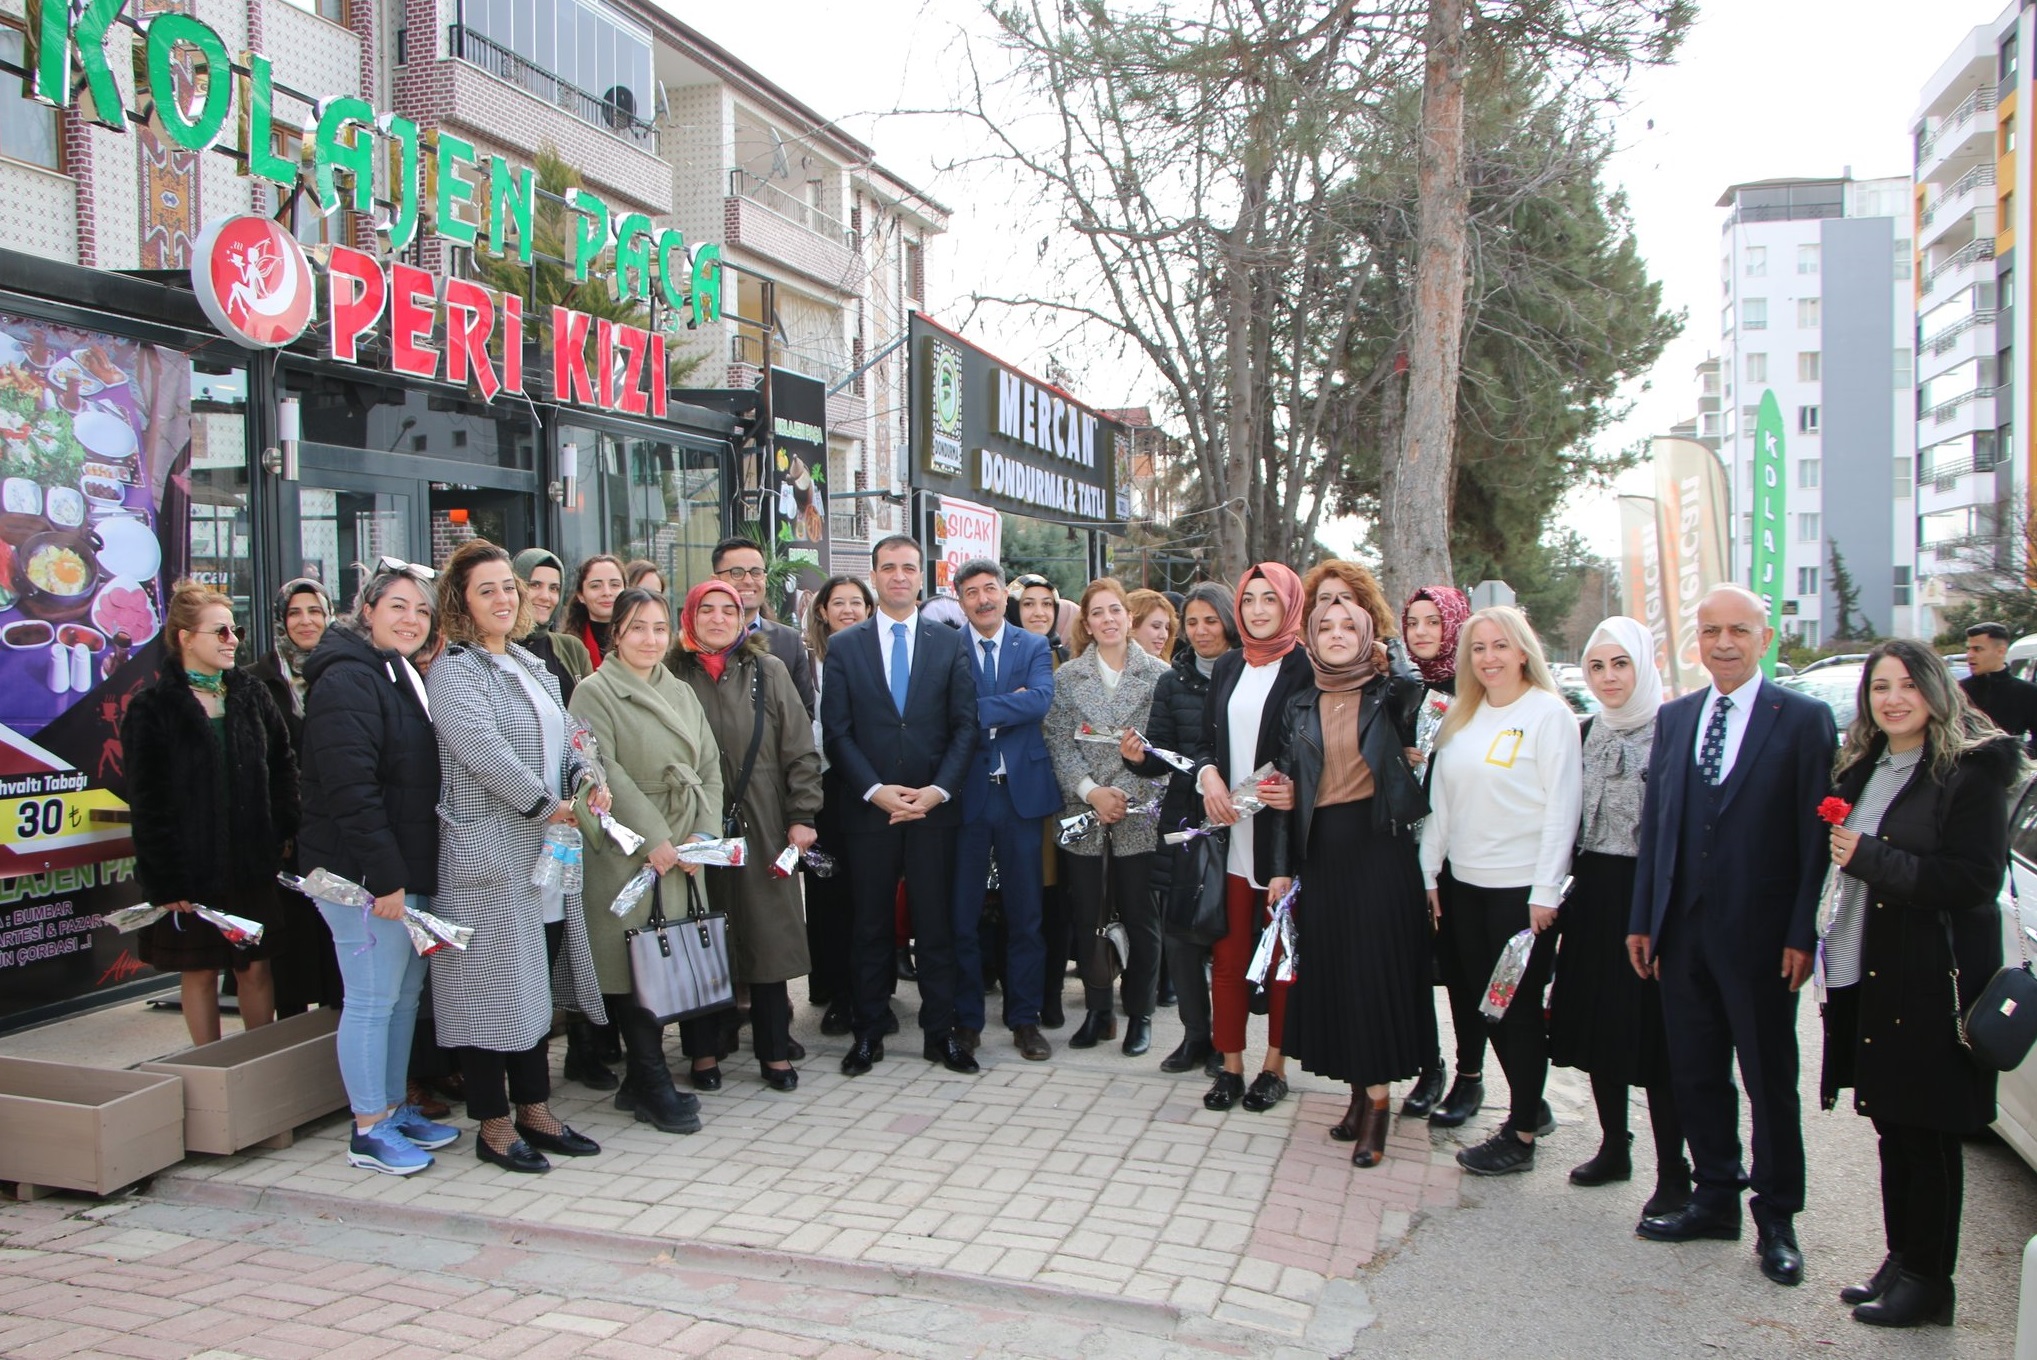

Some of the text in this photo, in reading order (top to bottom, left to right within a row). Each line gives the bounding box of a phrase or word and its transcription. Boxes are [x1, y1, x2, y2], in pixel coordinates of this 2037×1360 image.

[33, 0, 536, 267] KOLAJEN
[552, 305, 668, 419] KIZI
[999, 369, 1096, 468] MERCAN
[981, 449, 1107, 520] DONDURMA & TATLI
[947, 513, 991, 542] SICAK
[1762, 429, 1779, 616] KOLAJE
[0, 772, 88, 796] hvaltı Tabağı
[17, 797, 64, 839] 30
[0, 856, 136, 904] LAJEN PA
[13, 901, 73, 925] BUMBAR
[59, 914, 102, 935] PAZAR
[17, 937, 78, 966] ÇORBASI
